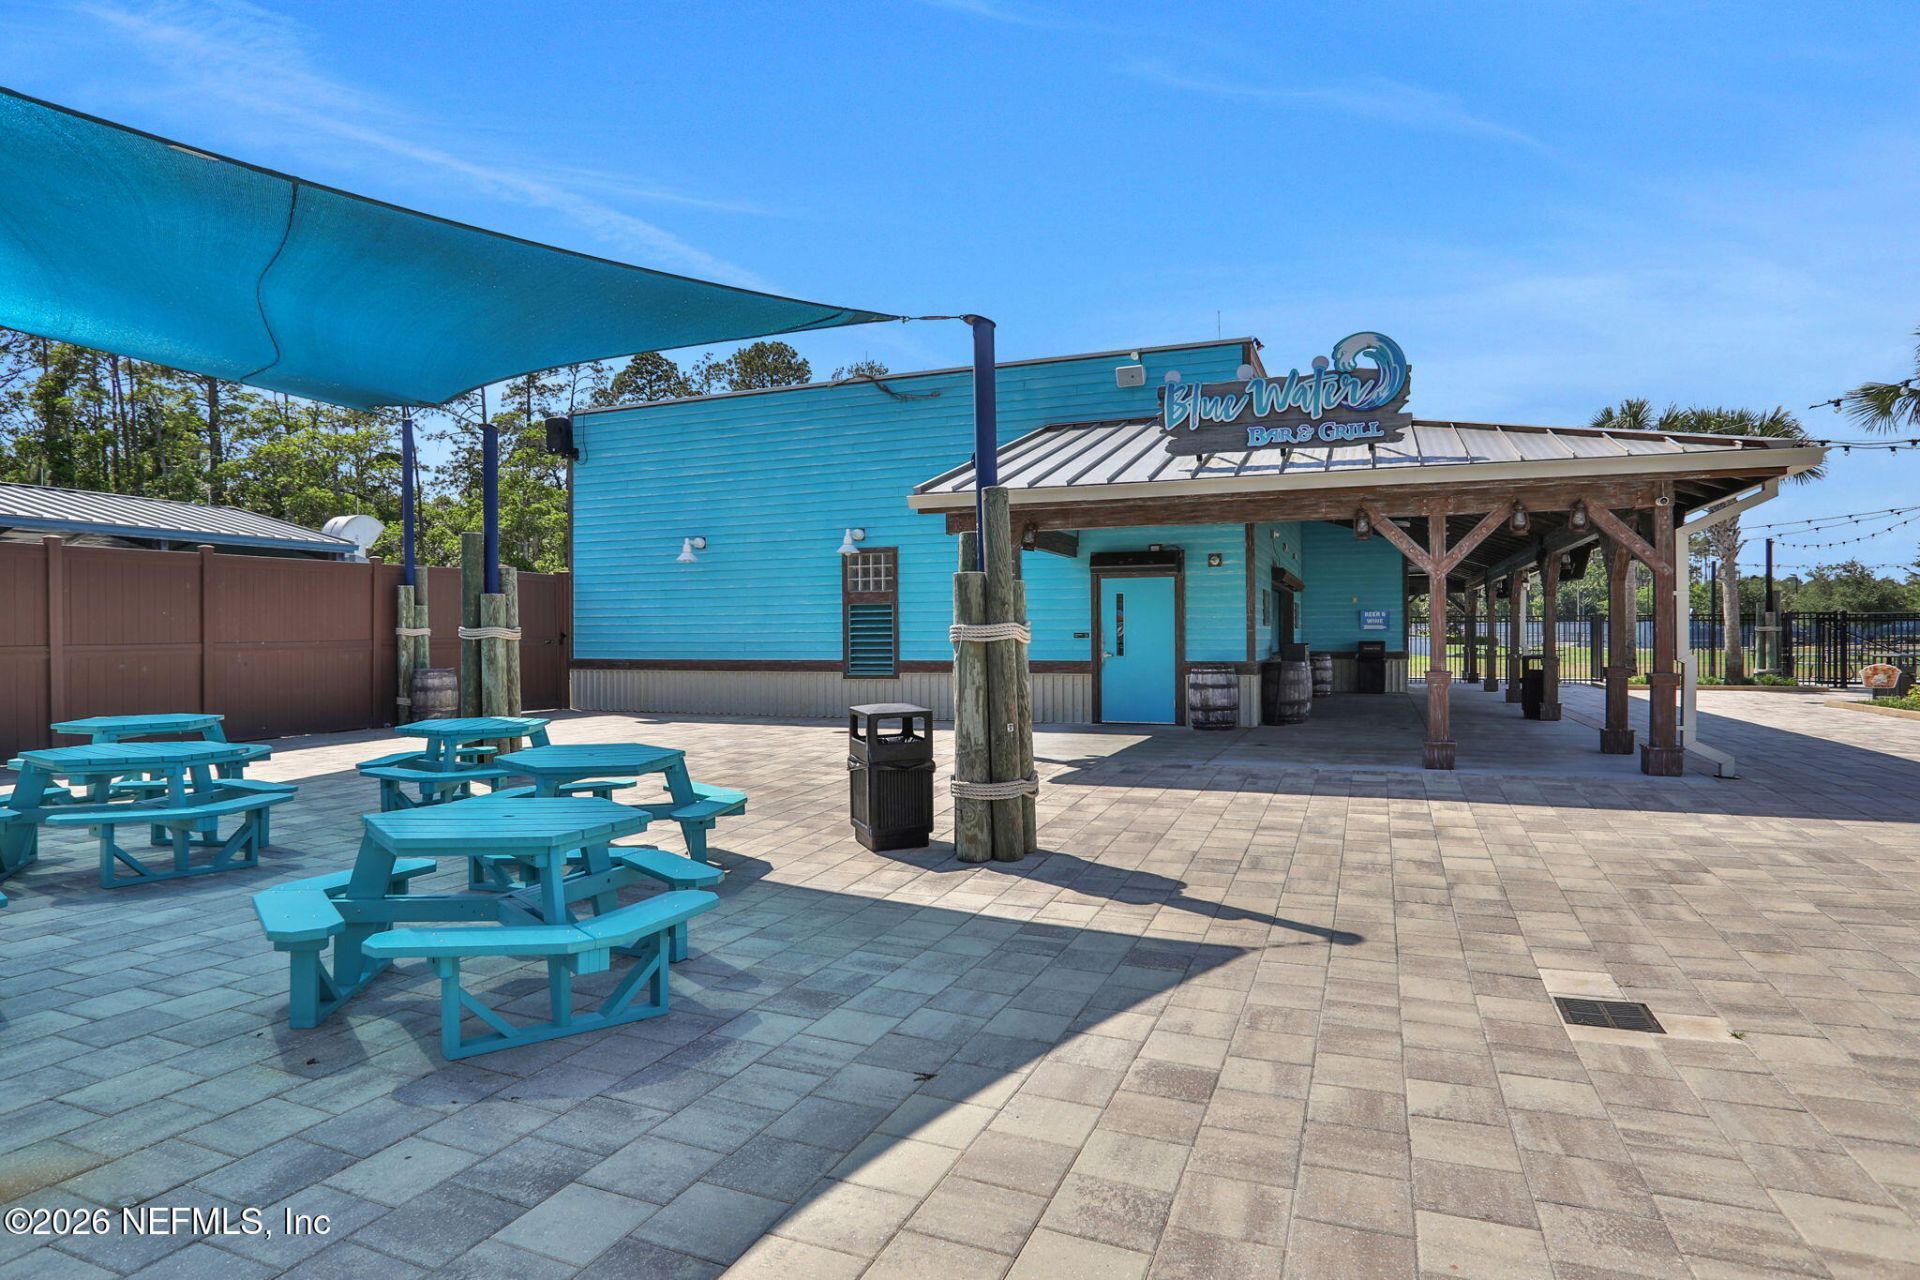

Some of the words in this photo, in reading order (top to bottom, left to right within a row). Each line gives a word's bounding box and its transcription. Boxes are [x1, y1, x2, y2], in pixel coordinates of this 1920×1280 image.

[1164, 382, 1249, 430] Blue
[1246, 368, 1375, 420] Water
[1247, 426, 1297, 447] BAR
[1297, 424, 1314, 441] &
[1318, 421, 1385, 442] GRILL
